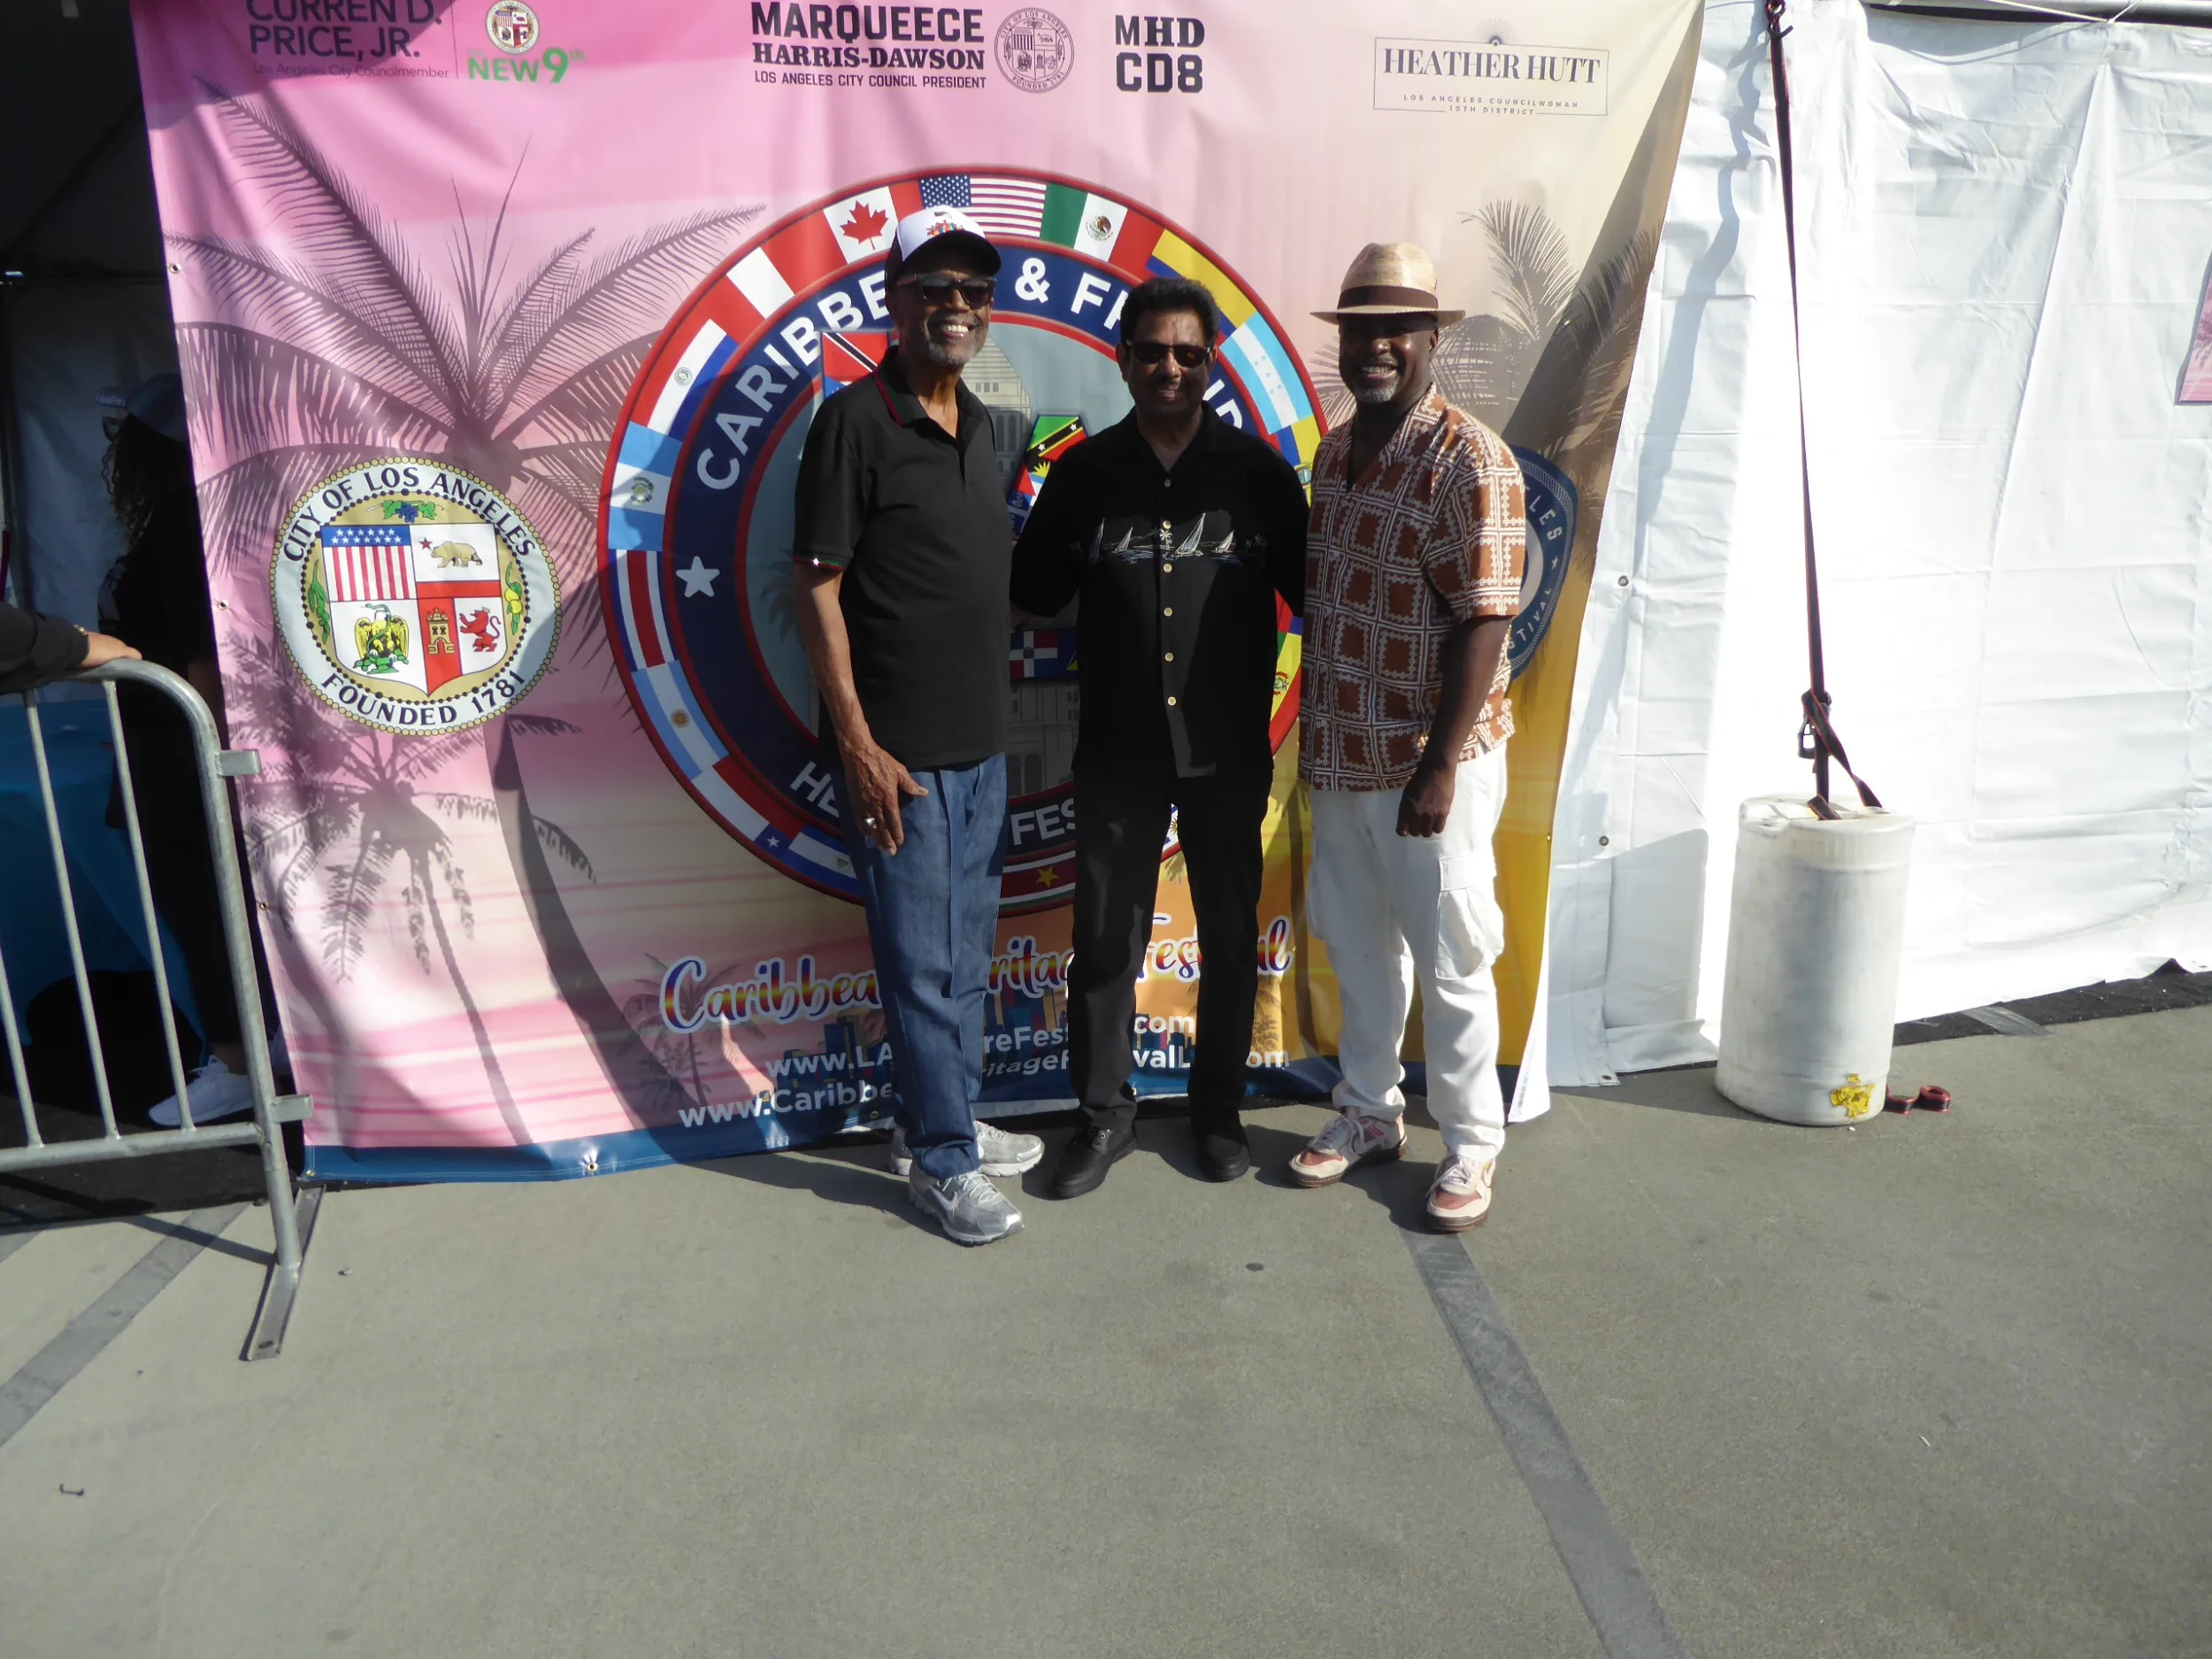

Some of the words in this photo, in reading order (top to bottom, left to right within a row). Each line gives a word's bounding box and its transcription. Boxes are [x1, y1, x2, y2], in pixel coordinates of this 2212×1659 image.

[246, 0, 396, 23] CURREN
[407, 0, 442, 25] D.
[751, 1, 984, 43] MARQUEECE
[249, 24, 364, 62] PRICE,
[370, 27, 420, 58] JR.
[1116, 14, 1205, 48] MHD
[254, 63, 273, 75] Los
[276, 63, 326, 77] Angeles
[329, 64, 351, 79] City
[355, 65, 449, 79] Councilmember
[468, 57, 540, 82] NEW
[752, 42, 985, 70] HARRIS-DAWSON
[1116, 51, 1203, 94] CD8
[1384, 48, 1521, 80] HEATHER
[1525, 54, 1601, 83] HUTT
[755, 71, 776, 84] LOS
[782, 73, 833, 86] ANGELES
[839, 74, 864, 87] CITY
[869, 75, 918, 88] COUNCIL
[923, 76, 987, 88] PRESIDENT
[1432, 95, 1482, 104] ANGELES
[1489, 97, 1578, 108] COUNCILWOMAN
[1483, 106, 1534, 116] DISTRICT
[697, 270, 890, 490] CARIBBE
[1015, 257, 1050, 303] &
[284, 510, 321, 563] CITY
[322, 479, 355, 510] OF
[363, 466, 420, 492] LOS
[430, 472, 536, 557] ANGELES
[321, 672, 457, 726] FOUNDED
[471, 671, 526, 714] 1781
[660, 954, 882, 1033] Caribbea
